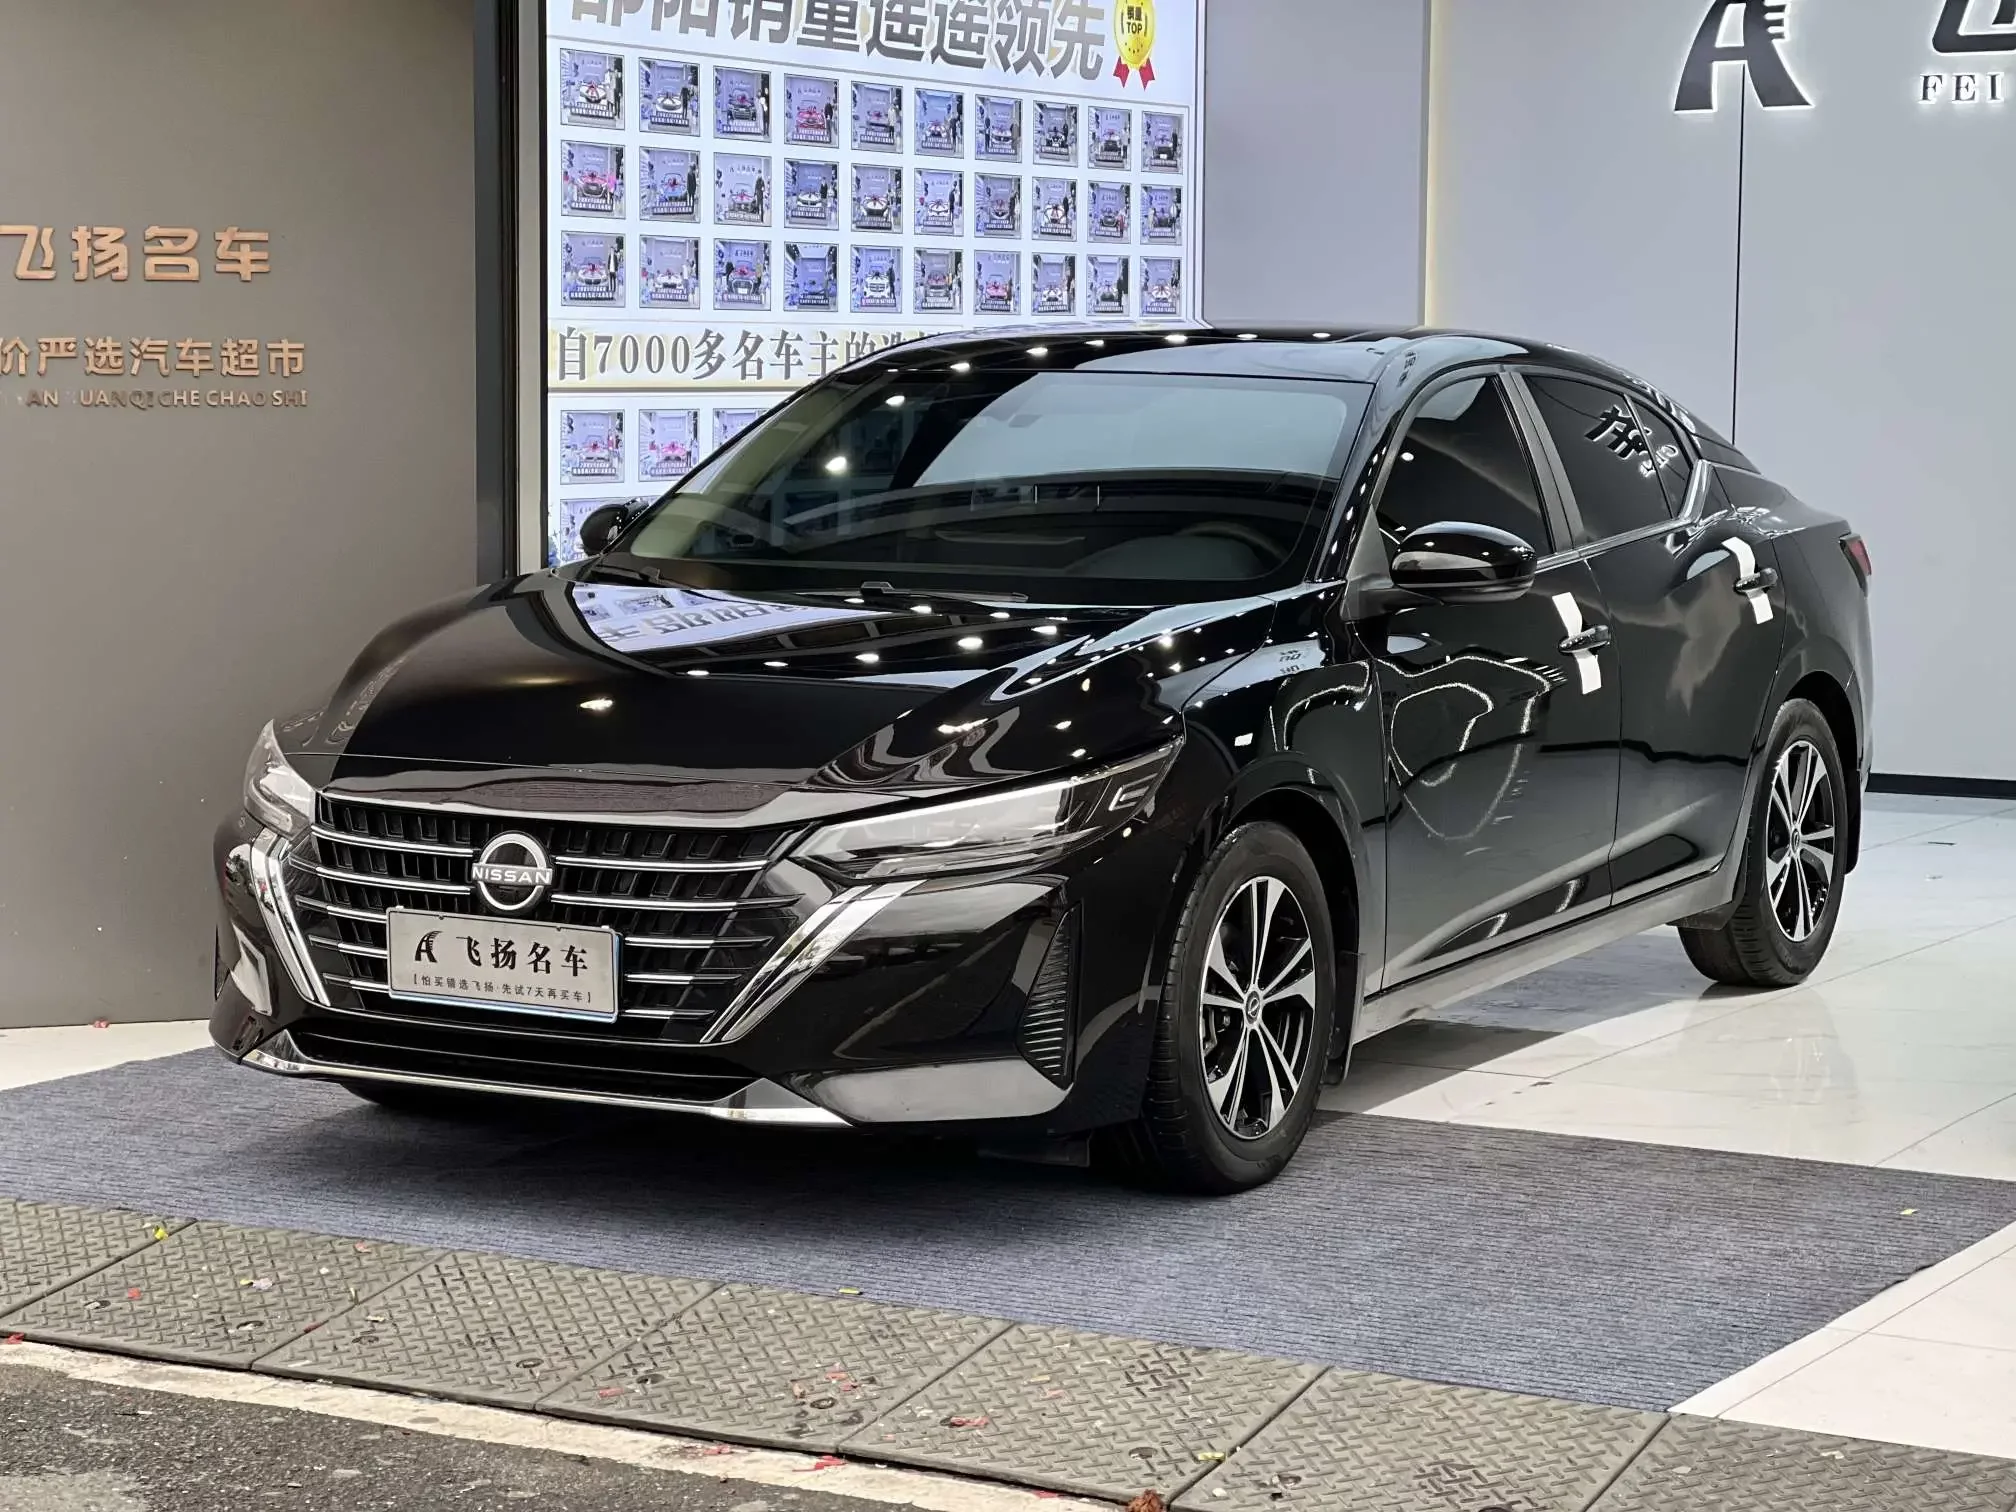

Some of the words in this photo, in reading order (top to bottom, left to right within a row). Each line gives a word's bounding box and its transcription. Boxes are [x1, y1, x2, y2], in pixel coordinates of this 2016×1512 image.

[1126, 21, 1143, 34] TOP
[1919, 73, 2004, 103] FEI
[0, 225, 270, 281] 飞扬名车
[558, 326, 943, 381] 自7000多名车主的
[472, 866, 550, 884] NISSAN
[455, 935, 588, 977] 飞扬名车
